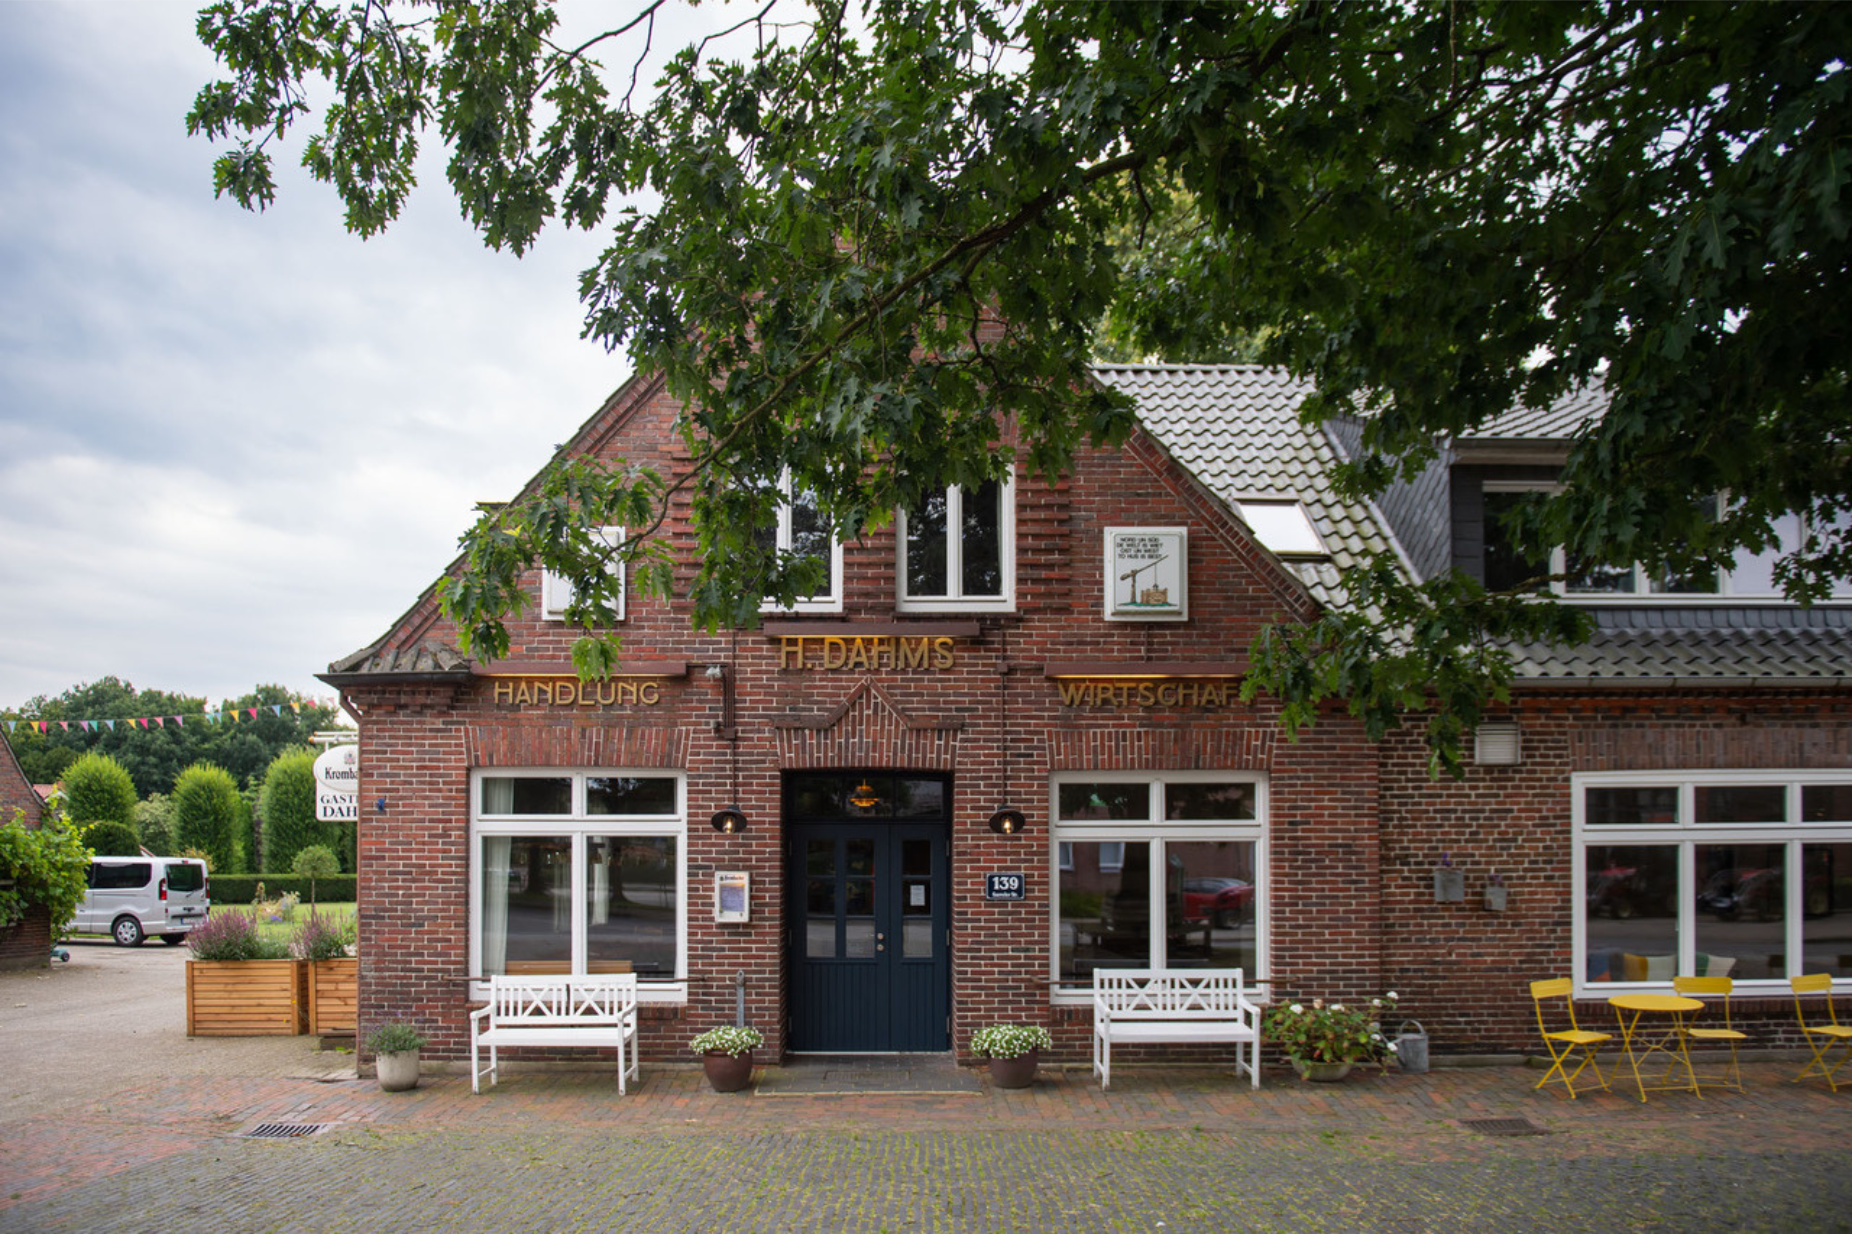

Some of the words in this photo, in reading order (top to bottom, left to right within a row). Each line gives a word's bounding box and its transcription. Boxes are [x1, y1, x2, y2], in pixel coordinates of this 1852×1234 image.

[780, 637, 812, 670] H.
[824, 637, 955, 670] DAHMS
[494, 681, 660, 705] HANDLUNG
[1058, 682, 1252, 706] WIRTSCHAF
[992, 876, 1019, 890] 139
